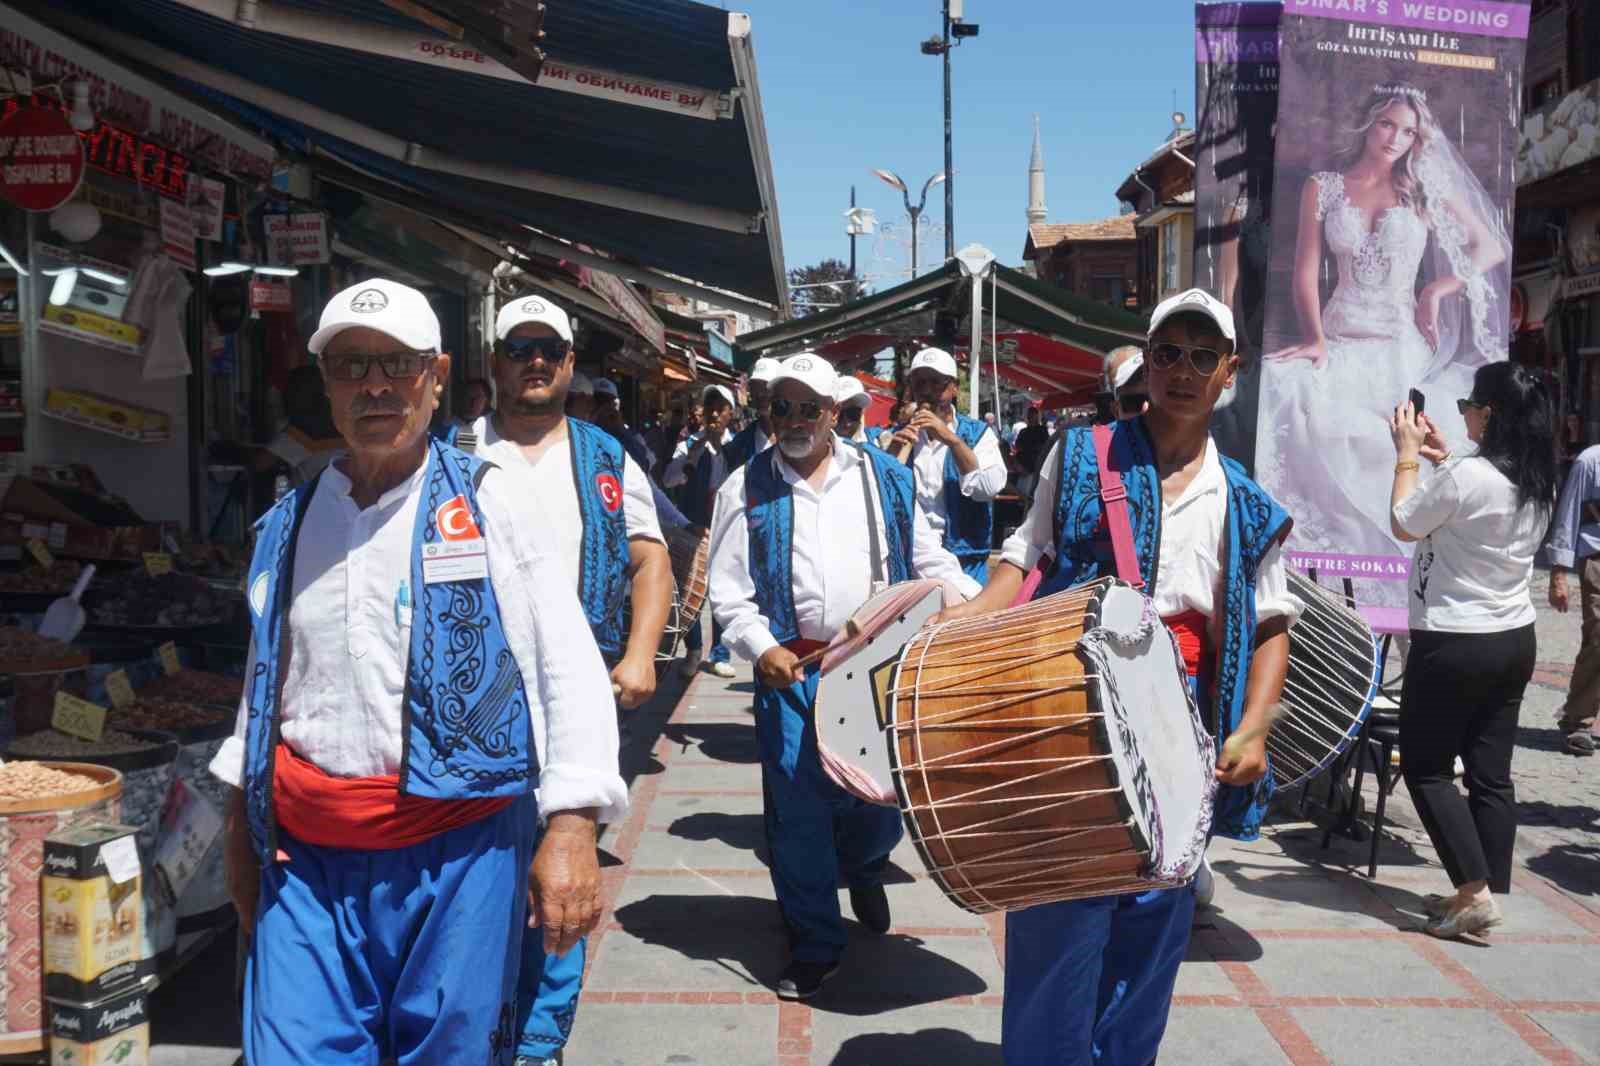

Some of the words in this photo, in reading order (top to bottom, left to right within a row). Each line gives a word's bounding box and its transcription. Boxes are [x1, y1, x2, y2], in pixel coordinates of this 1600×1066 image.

[1403, 4, 1510, 28] WEDDING
[576, 74, 673, 101] ОБИЧАМЕ
[678, 94, 705, 109] ВИ
[1289, 557, 1347, 571] METRE
[1351, 559, 1407, 574] SOKAK
